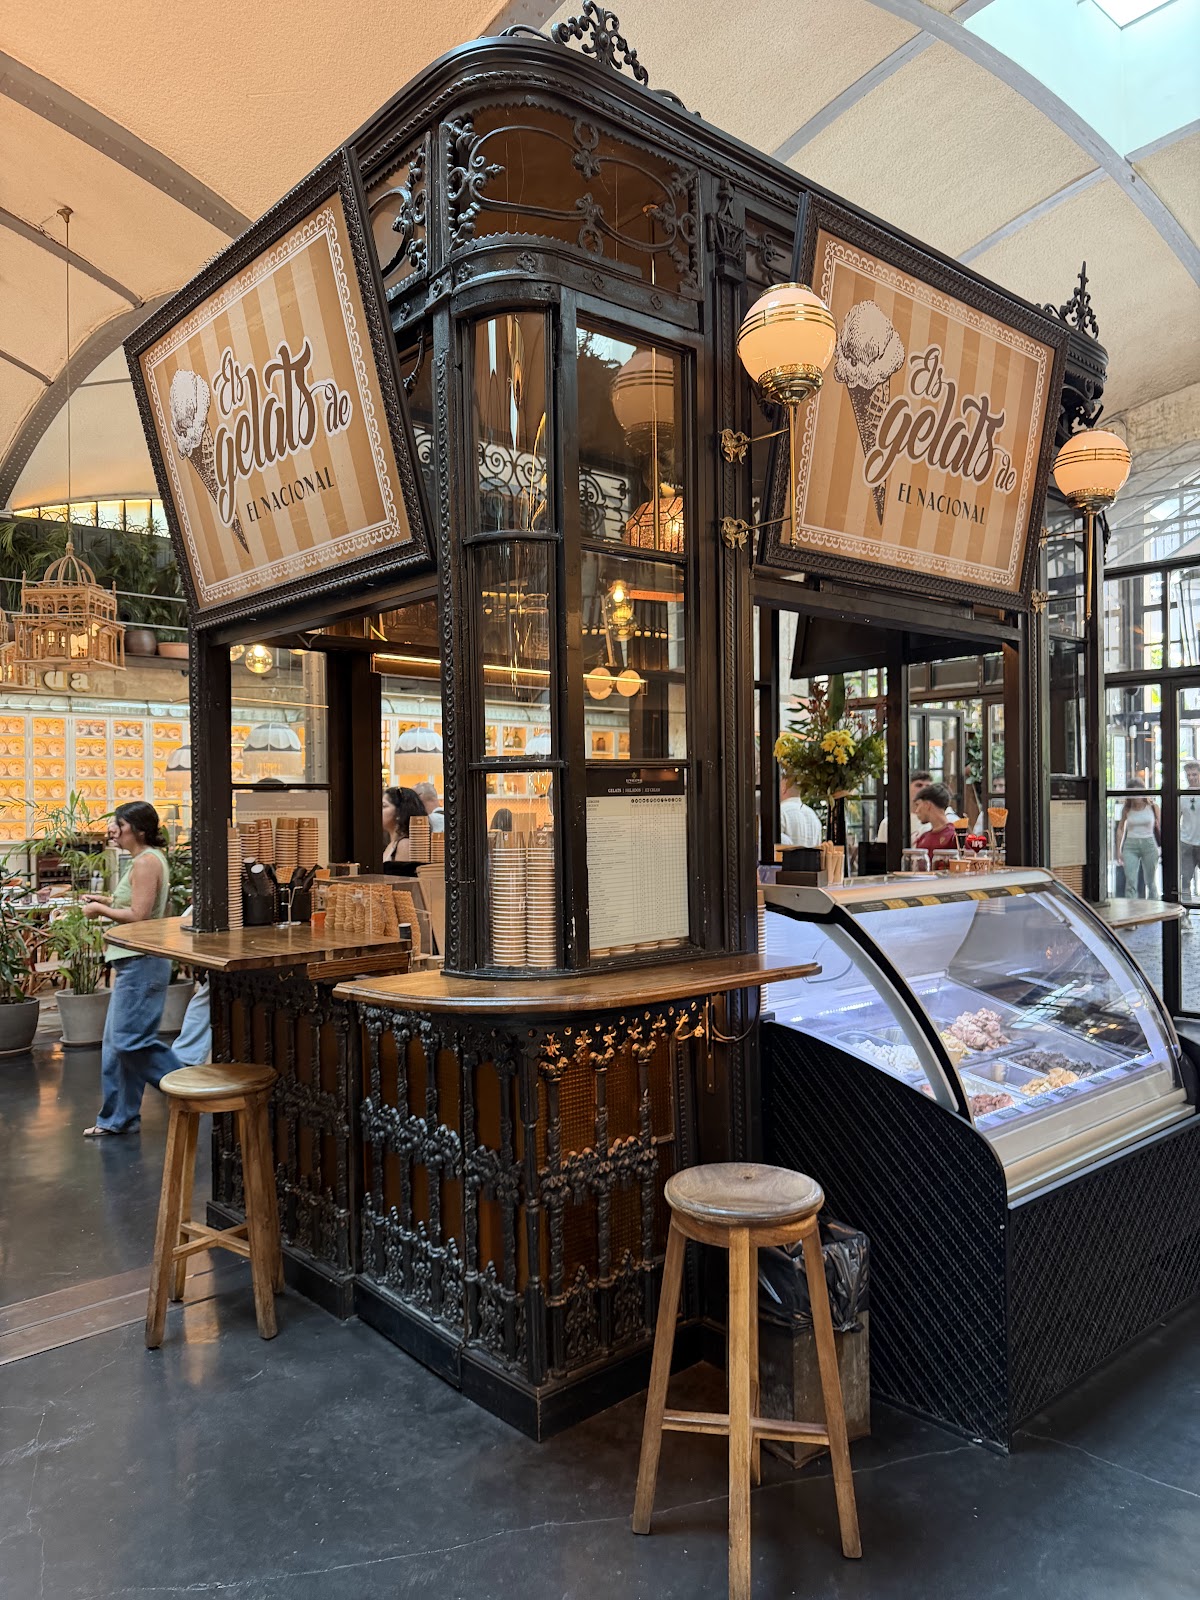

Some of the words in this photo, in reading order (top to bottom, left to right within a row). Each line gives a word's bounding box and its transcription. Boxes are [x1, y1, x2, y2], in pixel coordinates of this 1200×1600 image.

[213, 350, 244, 416] Els
[910, 347, 943, 400] Els
[215, 341, 316, 524] gelats
[324, 383, 351, 433] de
[864, 382, 1005, 484] gelats
[995, 454, 1016, 492] de
[246, 500, 262, 523] EL
[259, 466, 335, 515] NACIONAL
[897, 482, 912, 505] EL
[916, 487, 985, 525] NACIONAL
